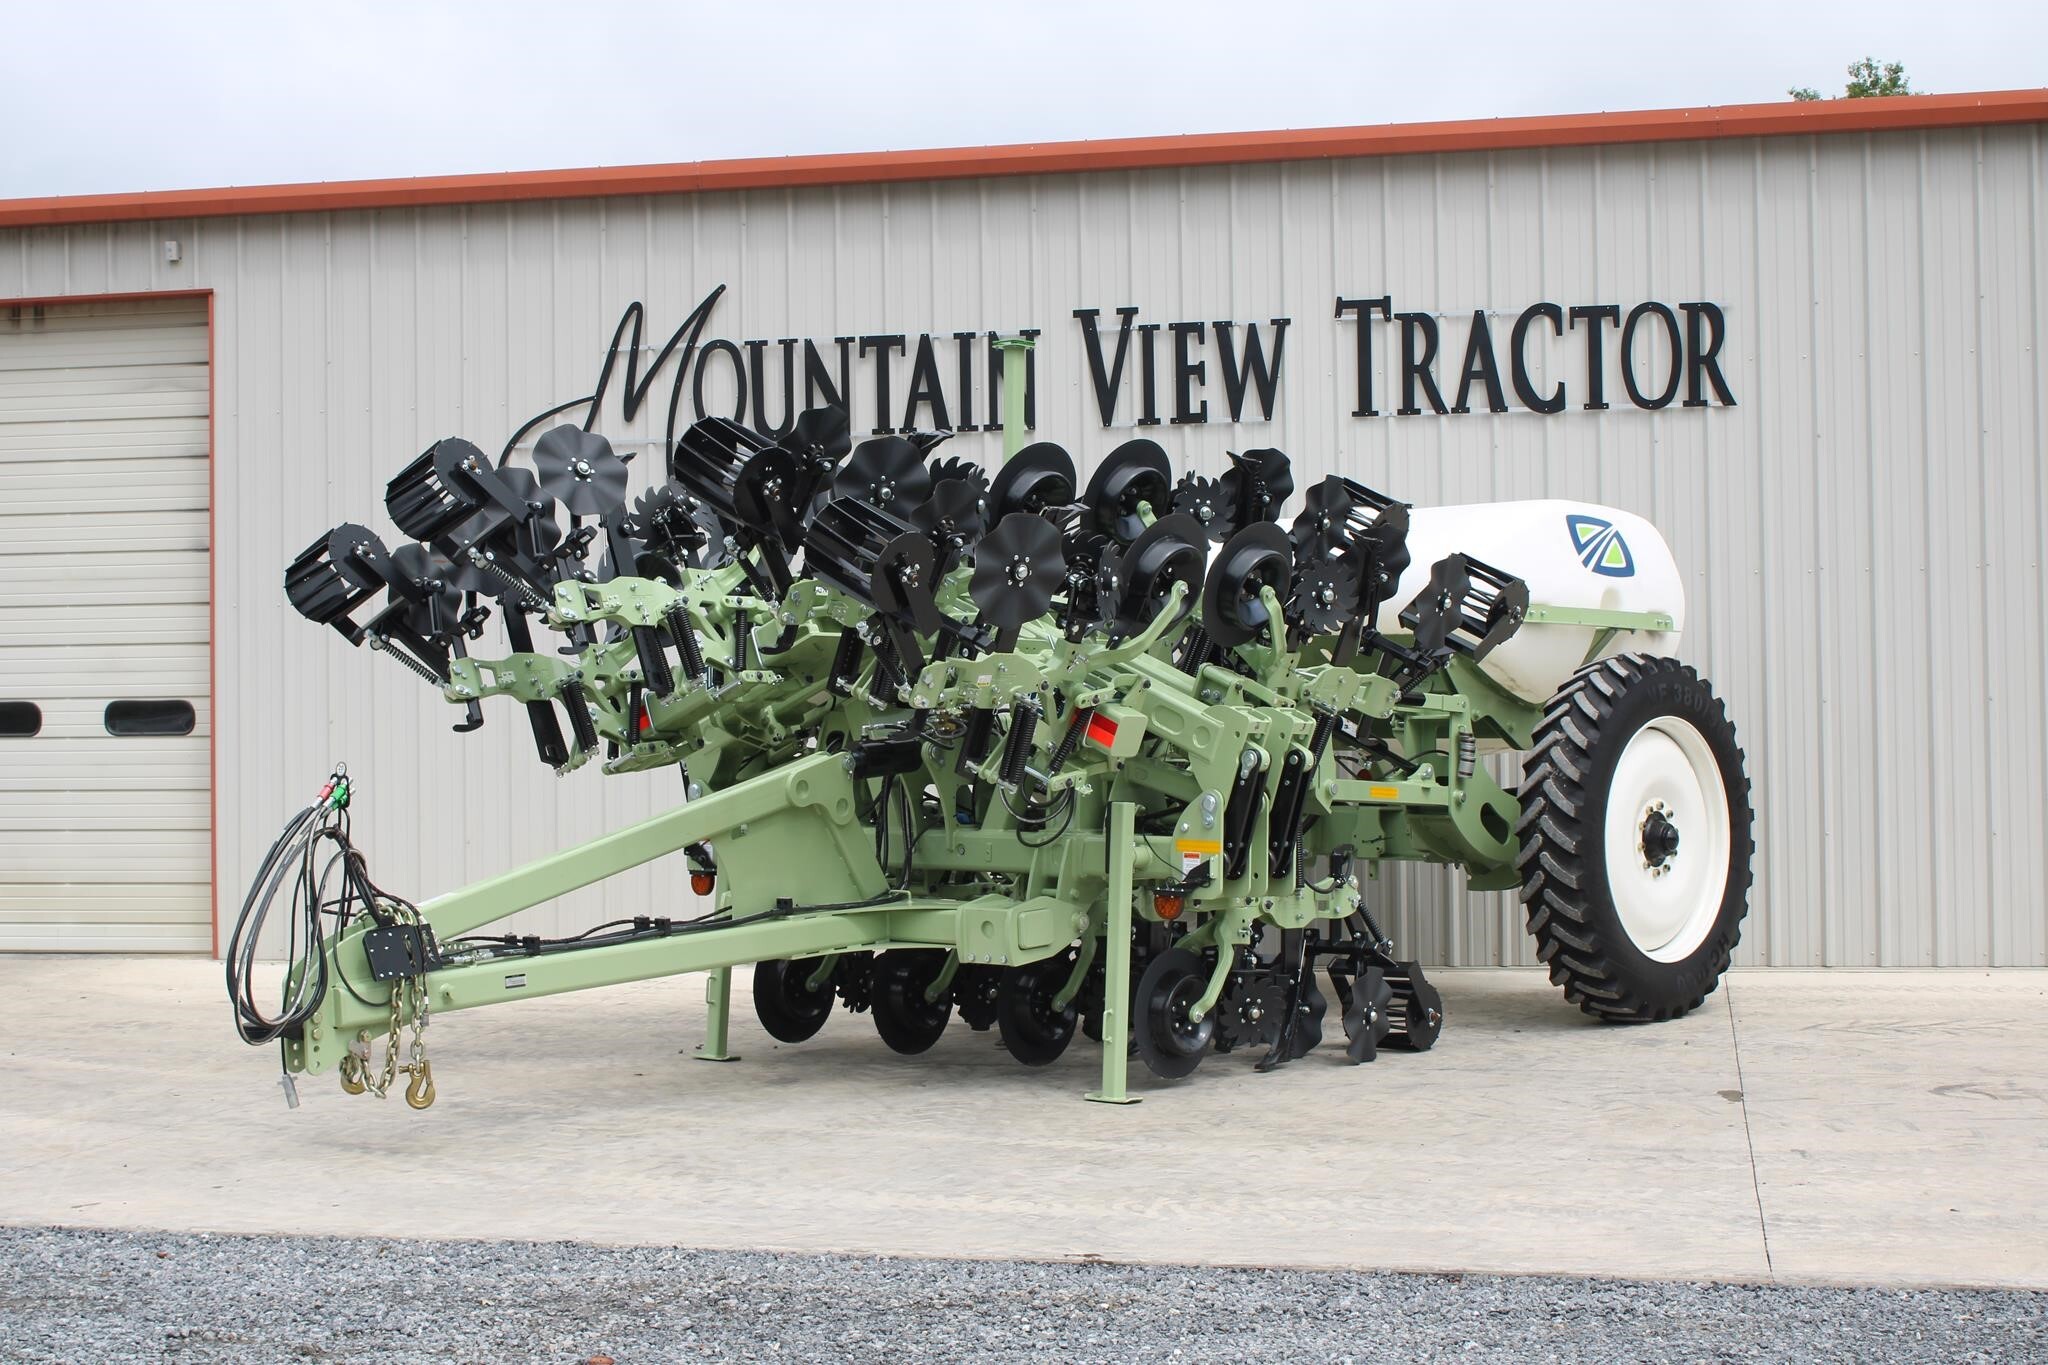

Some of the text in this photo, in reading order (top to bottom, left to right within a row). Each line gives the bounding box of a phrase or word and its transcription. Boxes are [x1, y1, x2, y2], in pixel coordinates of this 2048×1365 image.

[500, 283, 1736, 476] MOUNTAIN VIEW TRACTOR
